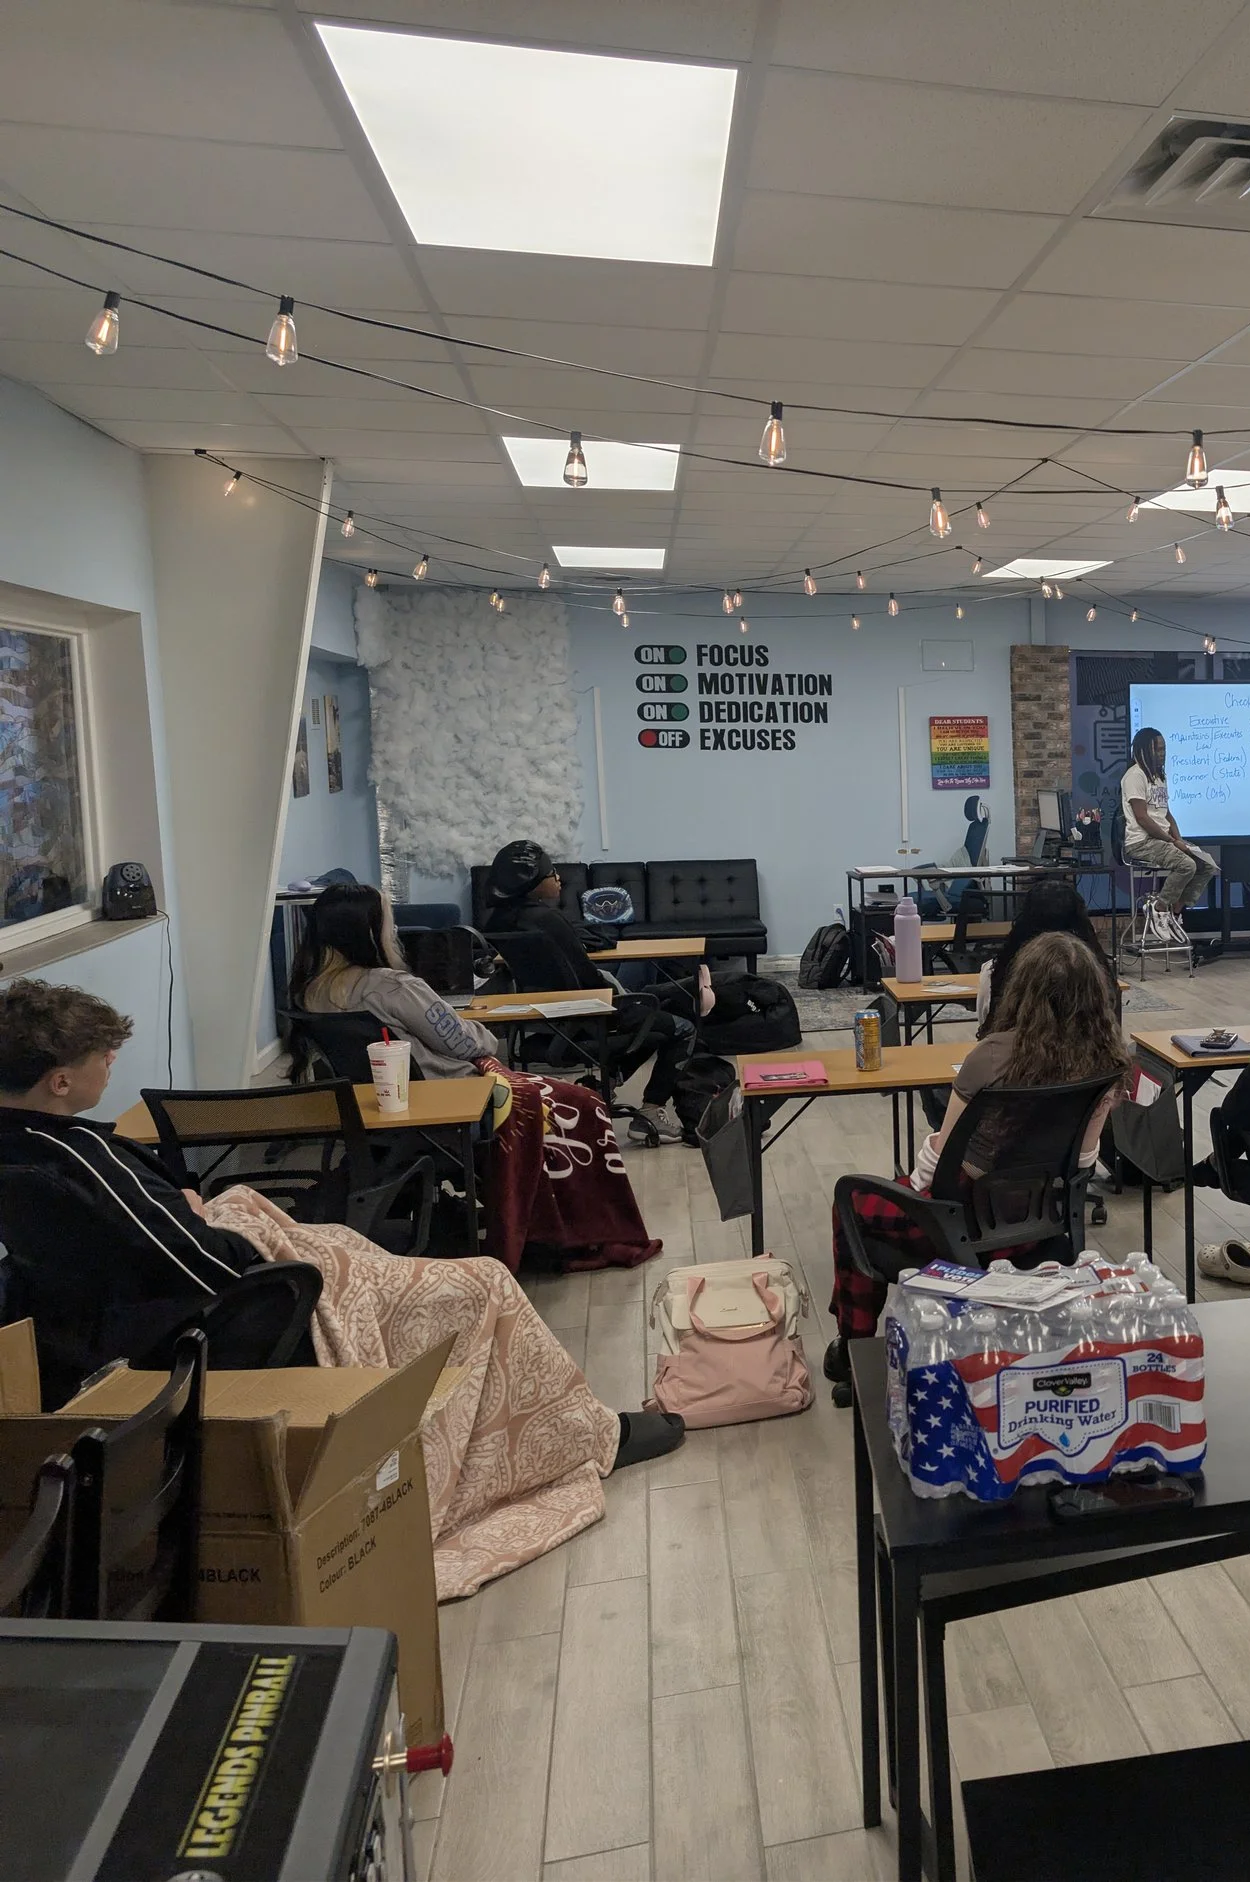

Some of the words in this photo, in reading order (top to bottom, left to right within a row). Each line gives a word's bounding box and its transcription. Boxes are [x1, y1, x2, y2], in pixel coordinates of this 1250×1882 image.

[640, 647, 665, 663] ON
[696, 644, 770, 667] FOCUS
[641, 676, 666, 692] ON
[697, 672, 833, 696] MOTIVATION
[643, 704, 668, 720] ON
[698, 701, 829, 724] DEDICATION
[1189, 713, 1231, 728] Executive
[658, 731, 683, 747] OFF
[699, 728, 796, 751] EXCUSES
[1171, 753, 1210, 767] President
[1172, 773, 1208, 785] Governor
[424, 1001, 481, 1060] LAGS
[936, 1265, 984, 1279] PLEDGE
[943, 1273, 978, 1284] VOTE
[1132, 1364, 1177, 1373] BOTTLES
[1147, 1352, 1164, 1363] 24
[1025, 1398, 1100, 1414] PURIFIED
[1008, 1413, 1074, 1433] Drinking
[1078, 1409, 1117, 1427] Water
[316, 1527, 361, 1570] Description:
[319, 1564, 347, 1593] Colour:
[347, 1536, 377, 1571] BLACK
[184, 1745, 265, 1858] LEGENDS
[229, 1654, 297, 1742] PINBALL
